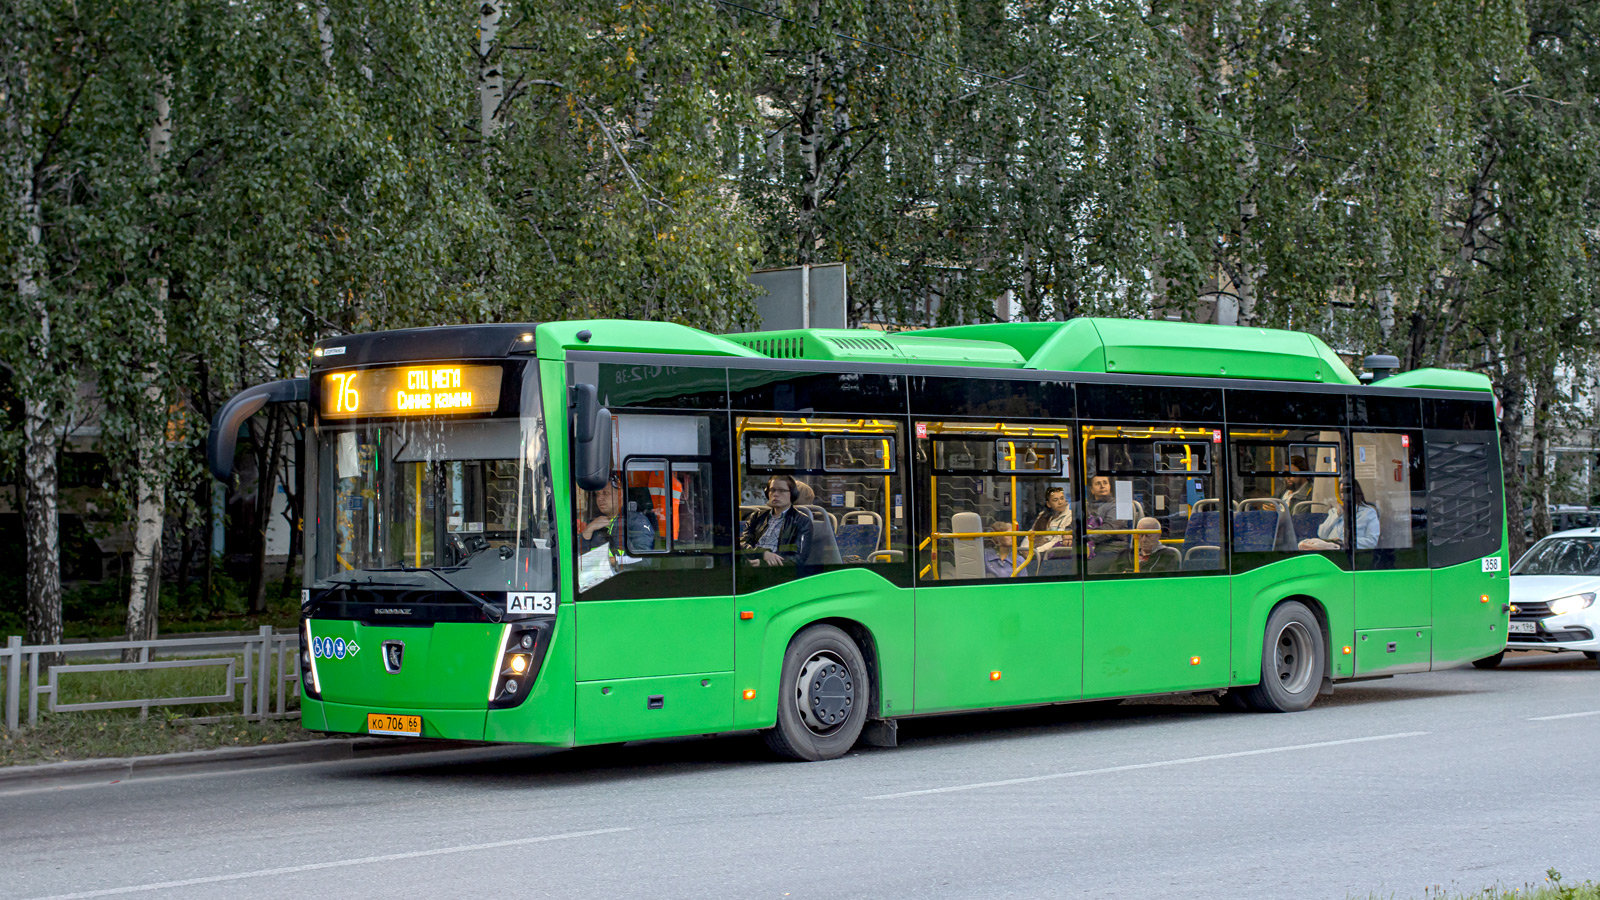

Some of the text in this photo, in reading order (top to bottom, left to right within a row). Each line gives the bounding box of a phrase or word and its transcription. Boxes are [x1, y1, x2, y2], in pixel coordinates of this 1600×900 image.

[407, 368, 461, 390] СТЦ МЕГА
[331, 373, 359, 413] 76
[434, 391, 472, 409] камни
[1485, 558, 1498, 571] 358
[510, 595, 553, 611] АП-3
[386, 716, 404, 730] 706
[408, 717, 418, 728] 66
